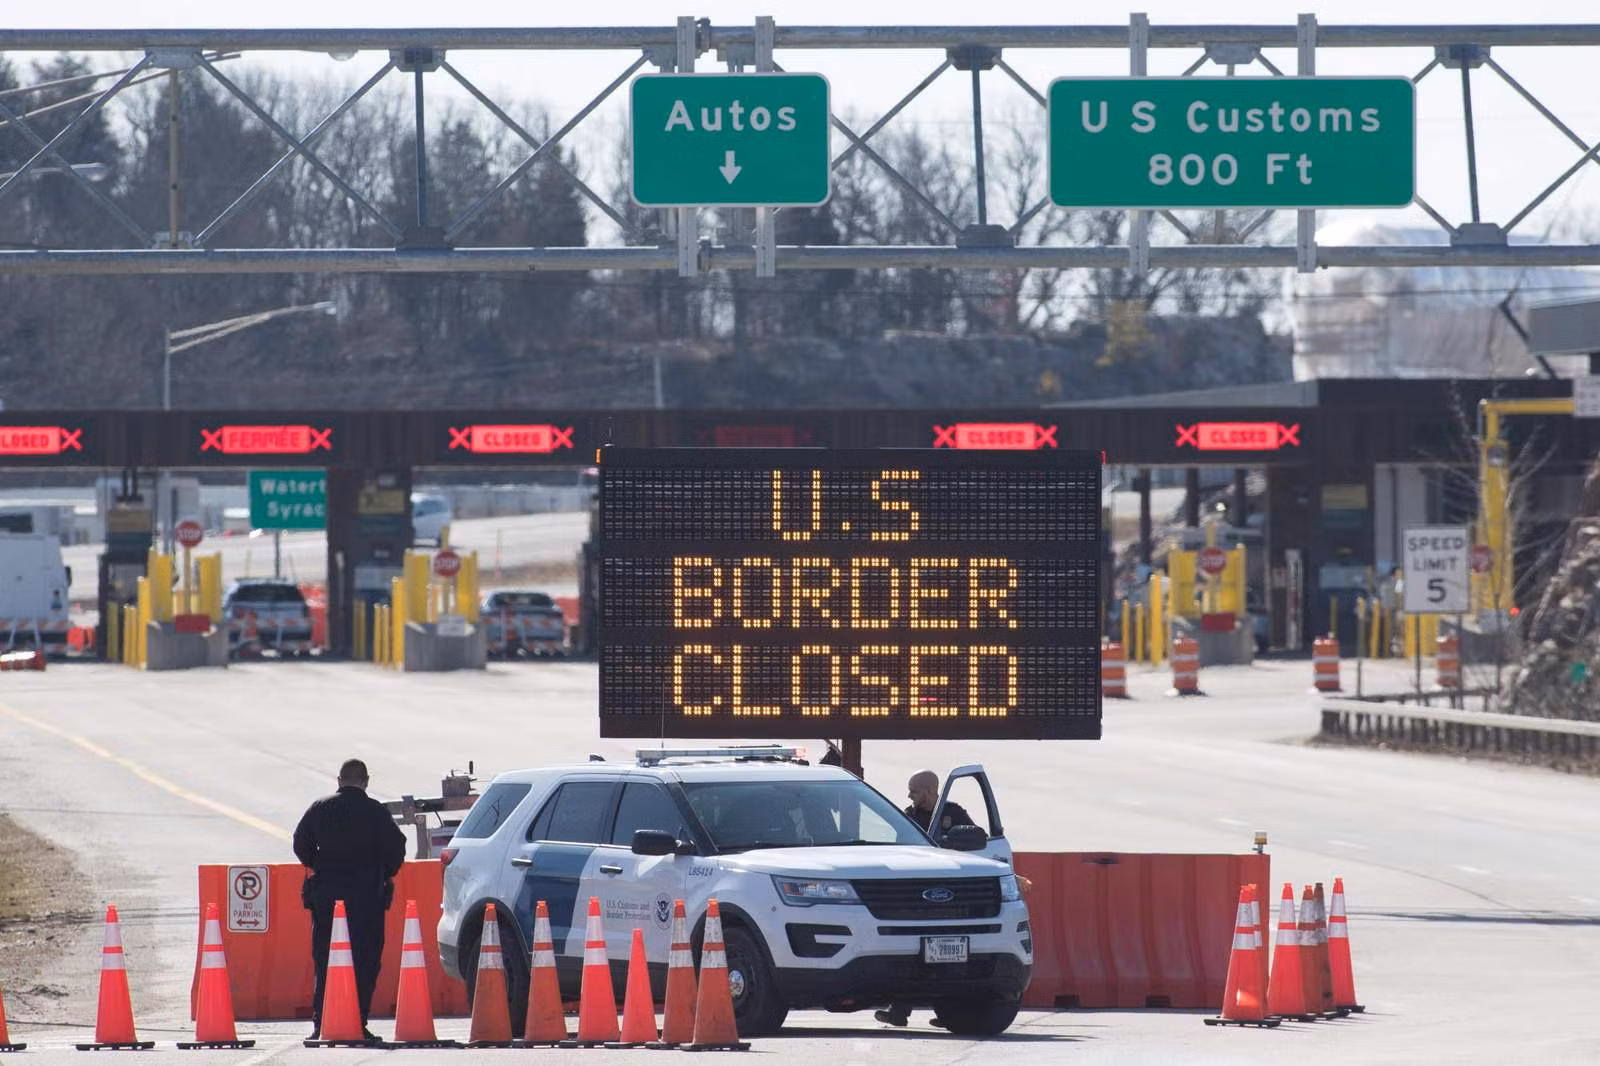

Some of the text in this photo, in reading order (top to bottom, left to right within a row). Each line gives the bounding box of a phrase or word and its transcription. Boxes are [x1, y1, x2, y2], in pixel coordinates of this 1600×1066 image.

[664, 99, 797, 132] Autos
[1081, 100, 1381, 133] U S Customs
[1149, 153, 1313, 186] 800 Ft
[228, 427, 300, 449] FERMÉE
[483, 431, 541, 447] CLOSED
[967, 430, 1025, 445] CLOSED
[1210, 429, 1268, 444] CLOSED
[176, 527, 203, 540] STOP
[1407, 536, 1464, 551] SPEED
[1412, 556, 1457, 572] LIMIT
[673, 557, 1018, 629] BORDER
[1427, 578, 1447, 603] 5
[673, 645, 1018, 717] CLOSED
[233, 910, 263, 918] PARKING
